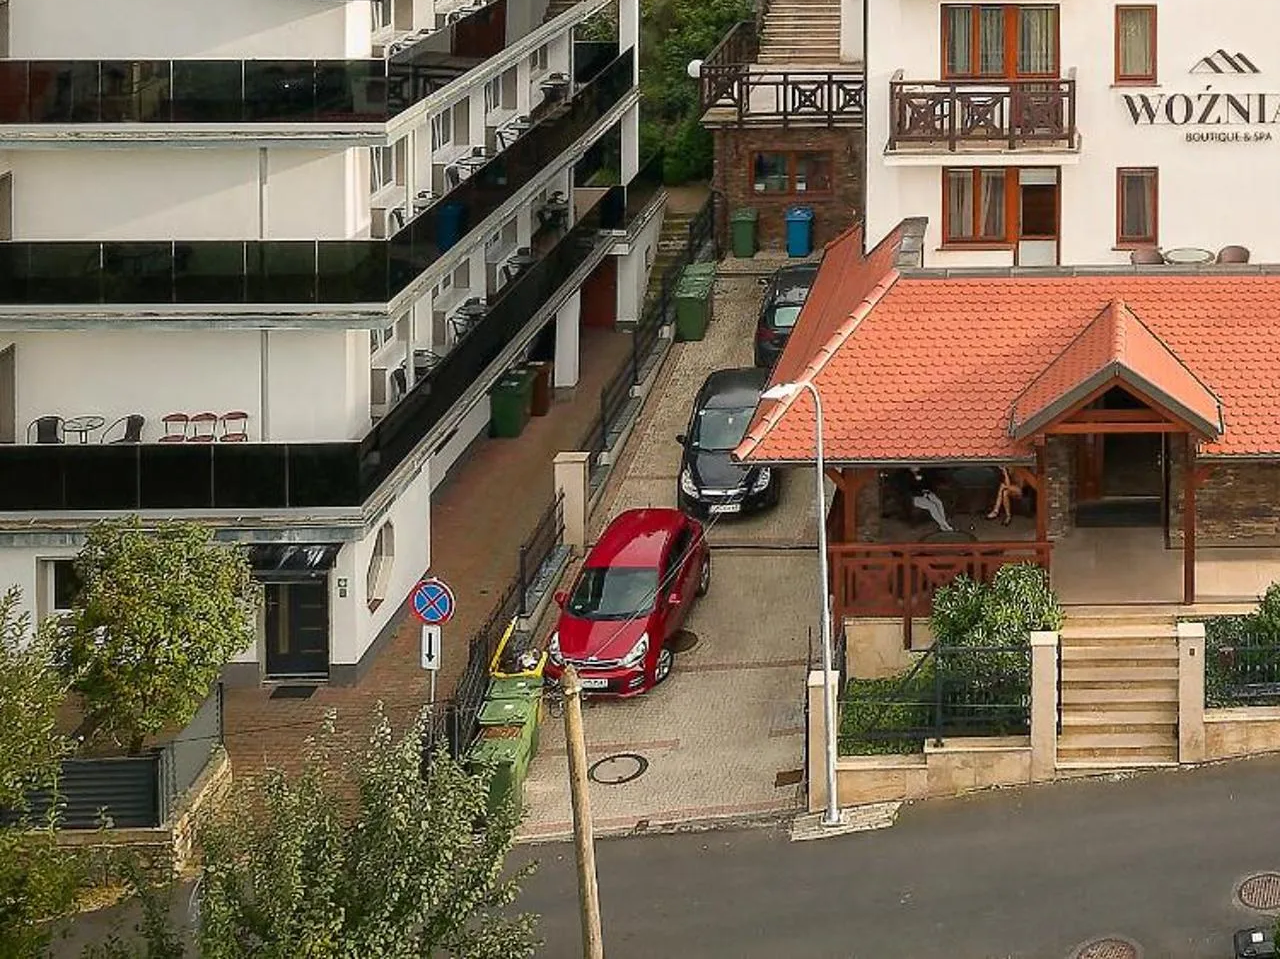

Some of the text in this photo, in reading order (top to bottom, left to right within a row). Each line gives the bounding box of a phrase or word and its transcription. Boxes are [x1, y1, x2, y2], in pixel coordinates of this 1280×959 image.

[1185, 131, 1273, 143] BOUTIQUE & SPA
